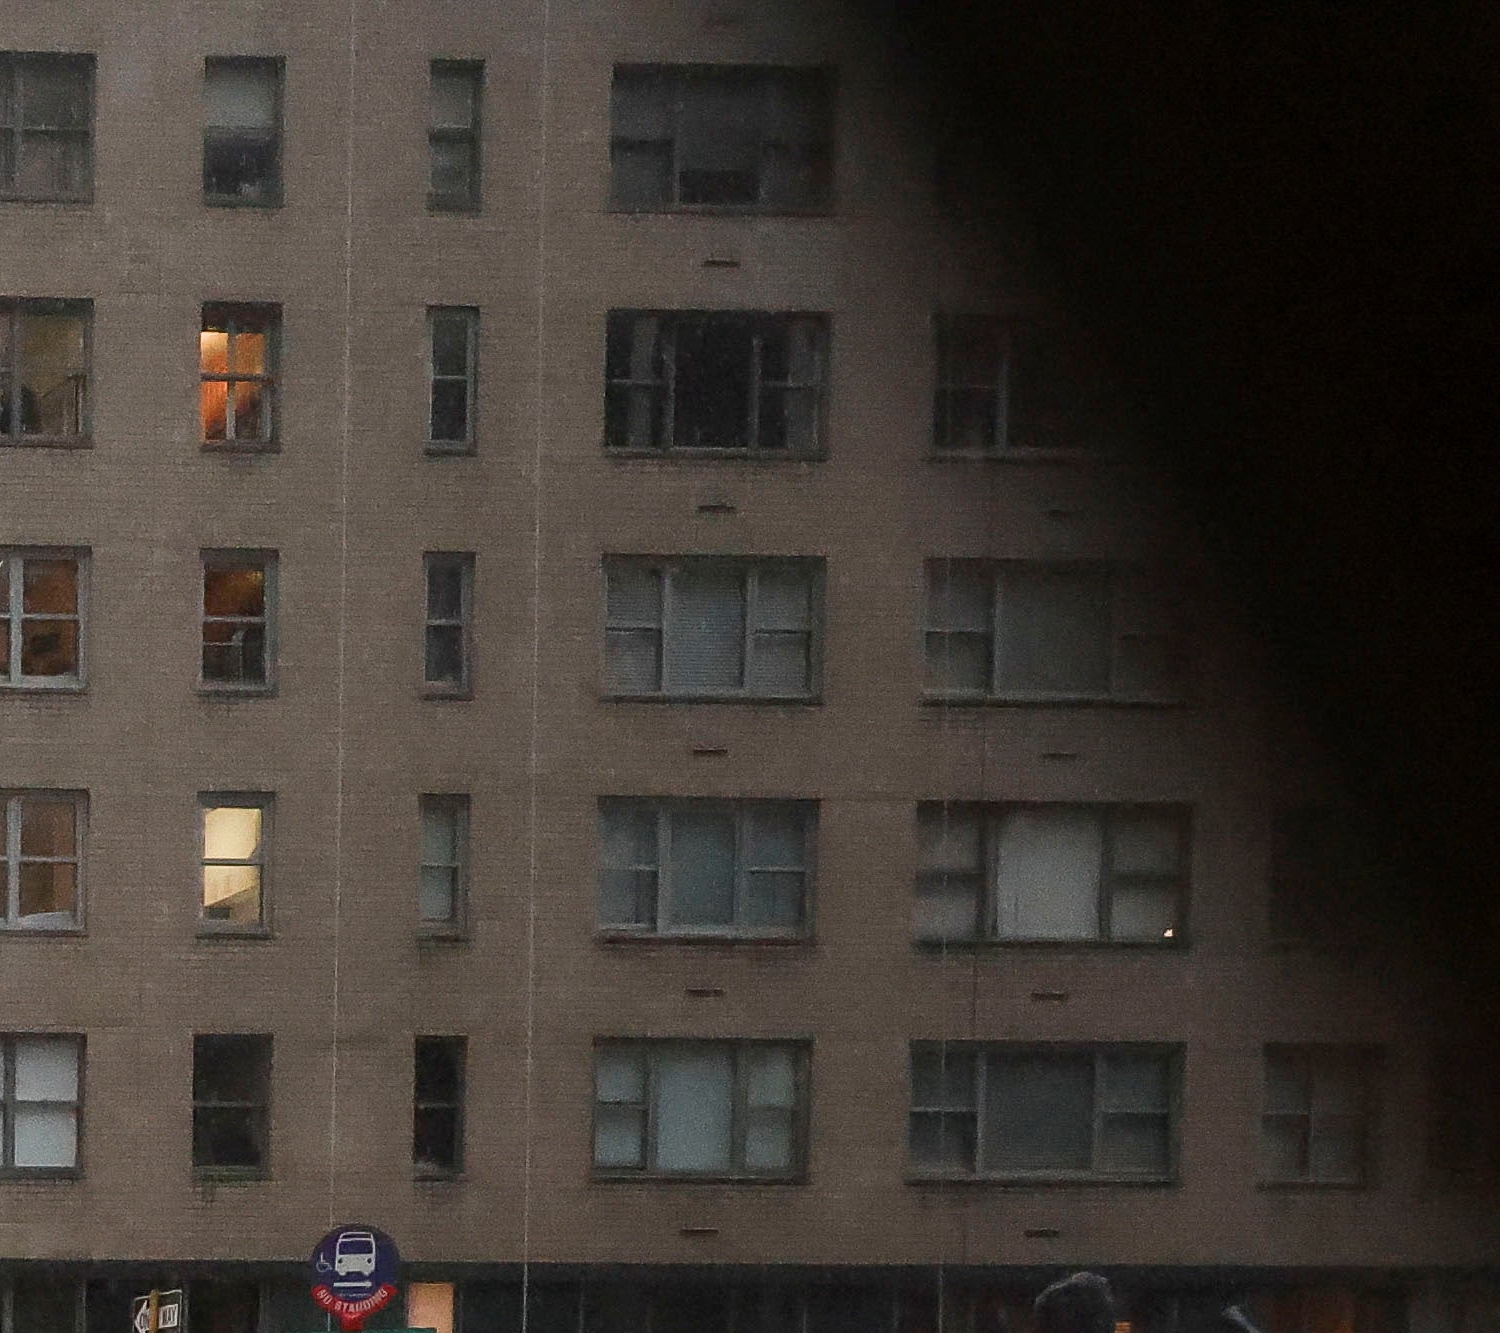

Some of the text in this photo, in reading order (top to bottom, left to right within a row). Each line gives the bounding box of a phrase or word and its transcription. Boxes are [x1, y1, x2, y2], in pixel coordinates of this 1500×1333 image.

[316, 1288, 389, 1314] NO STANDING
[162, 1306, 178, 1326] WAY
